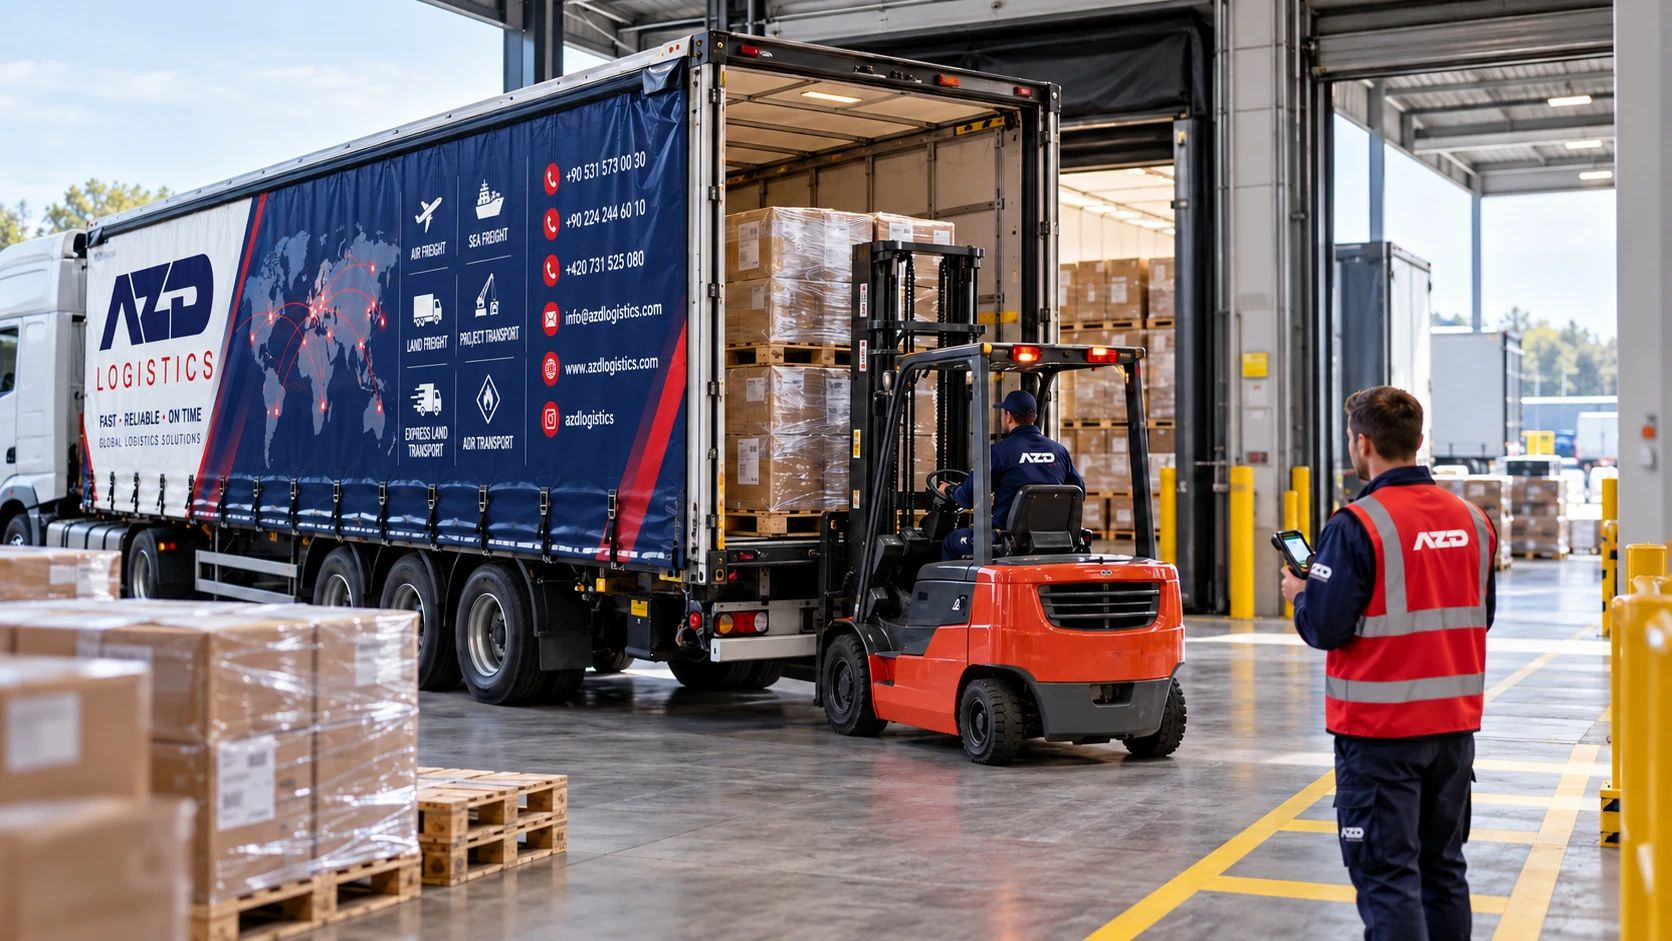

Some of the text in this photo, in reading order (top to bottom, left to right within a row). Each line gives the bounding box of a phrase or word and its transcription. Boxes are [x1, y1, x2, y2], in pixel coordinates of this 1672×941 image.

[566, 151, 646, 182] +90 531 573 00 30
[566, 199, 646, 228] +90 224 244 60 10
[468, 227, 509, 248] SEA FREIGHT
[411, 241, 447, 260] AIR FREIGHT
[565, 250, 645, 276] +420 731 525 080
[99, 253, 214, 351] AZD
[565, 303, 662, 325] info@azdlogistics.com
[407, 335, 448, 352] LAND FREIGHT
[460, 325, 520, 348] PROJECT TRANSPORT
[97, 350, 213, 391] LOGISTICS
[565, 356, 659, 376] www.azdlogistics.com
[100, 407, 202, 428] FAST RELIABLE ON TIME
[565, 409, 614, 430] azdlogistics
[99, 433, 200, 448] GLOBAL LOGISTICS SOLUTIONS
[405, 426, 448, 440] EXPRESS LAND
[463, 436, 514, 450] ADR TRANSPORT
[408, 443, 443, 457] TRANSPORT
[1019, 452, 1055, 464] AZD
[1413, 529, 1469, 551] AZD
[1310, 563, 1333, 580] ZD
[1341, 827, 1365, 838] AZD
